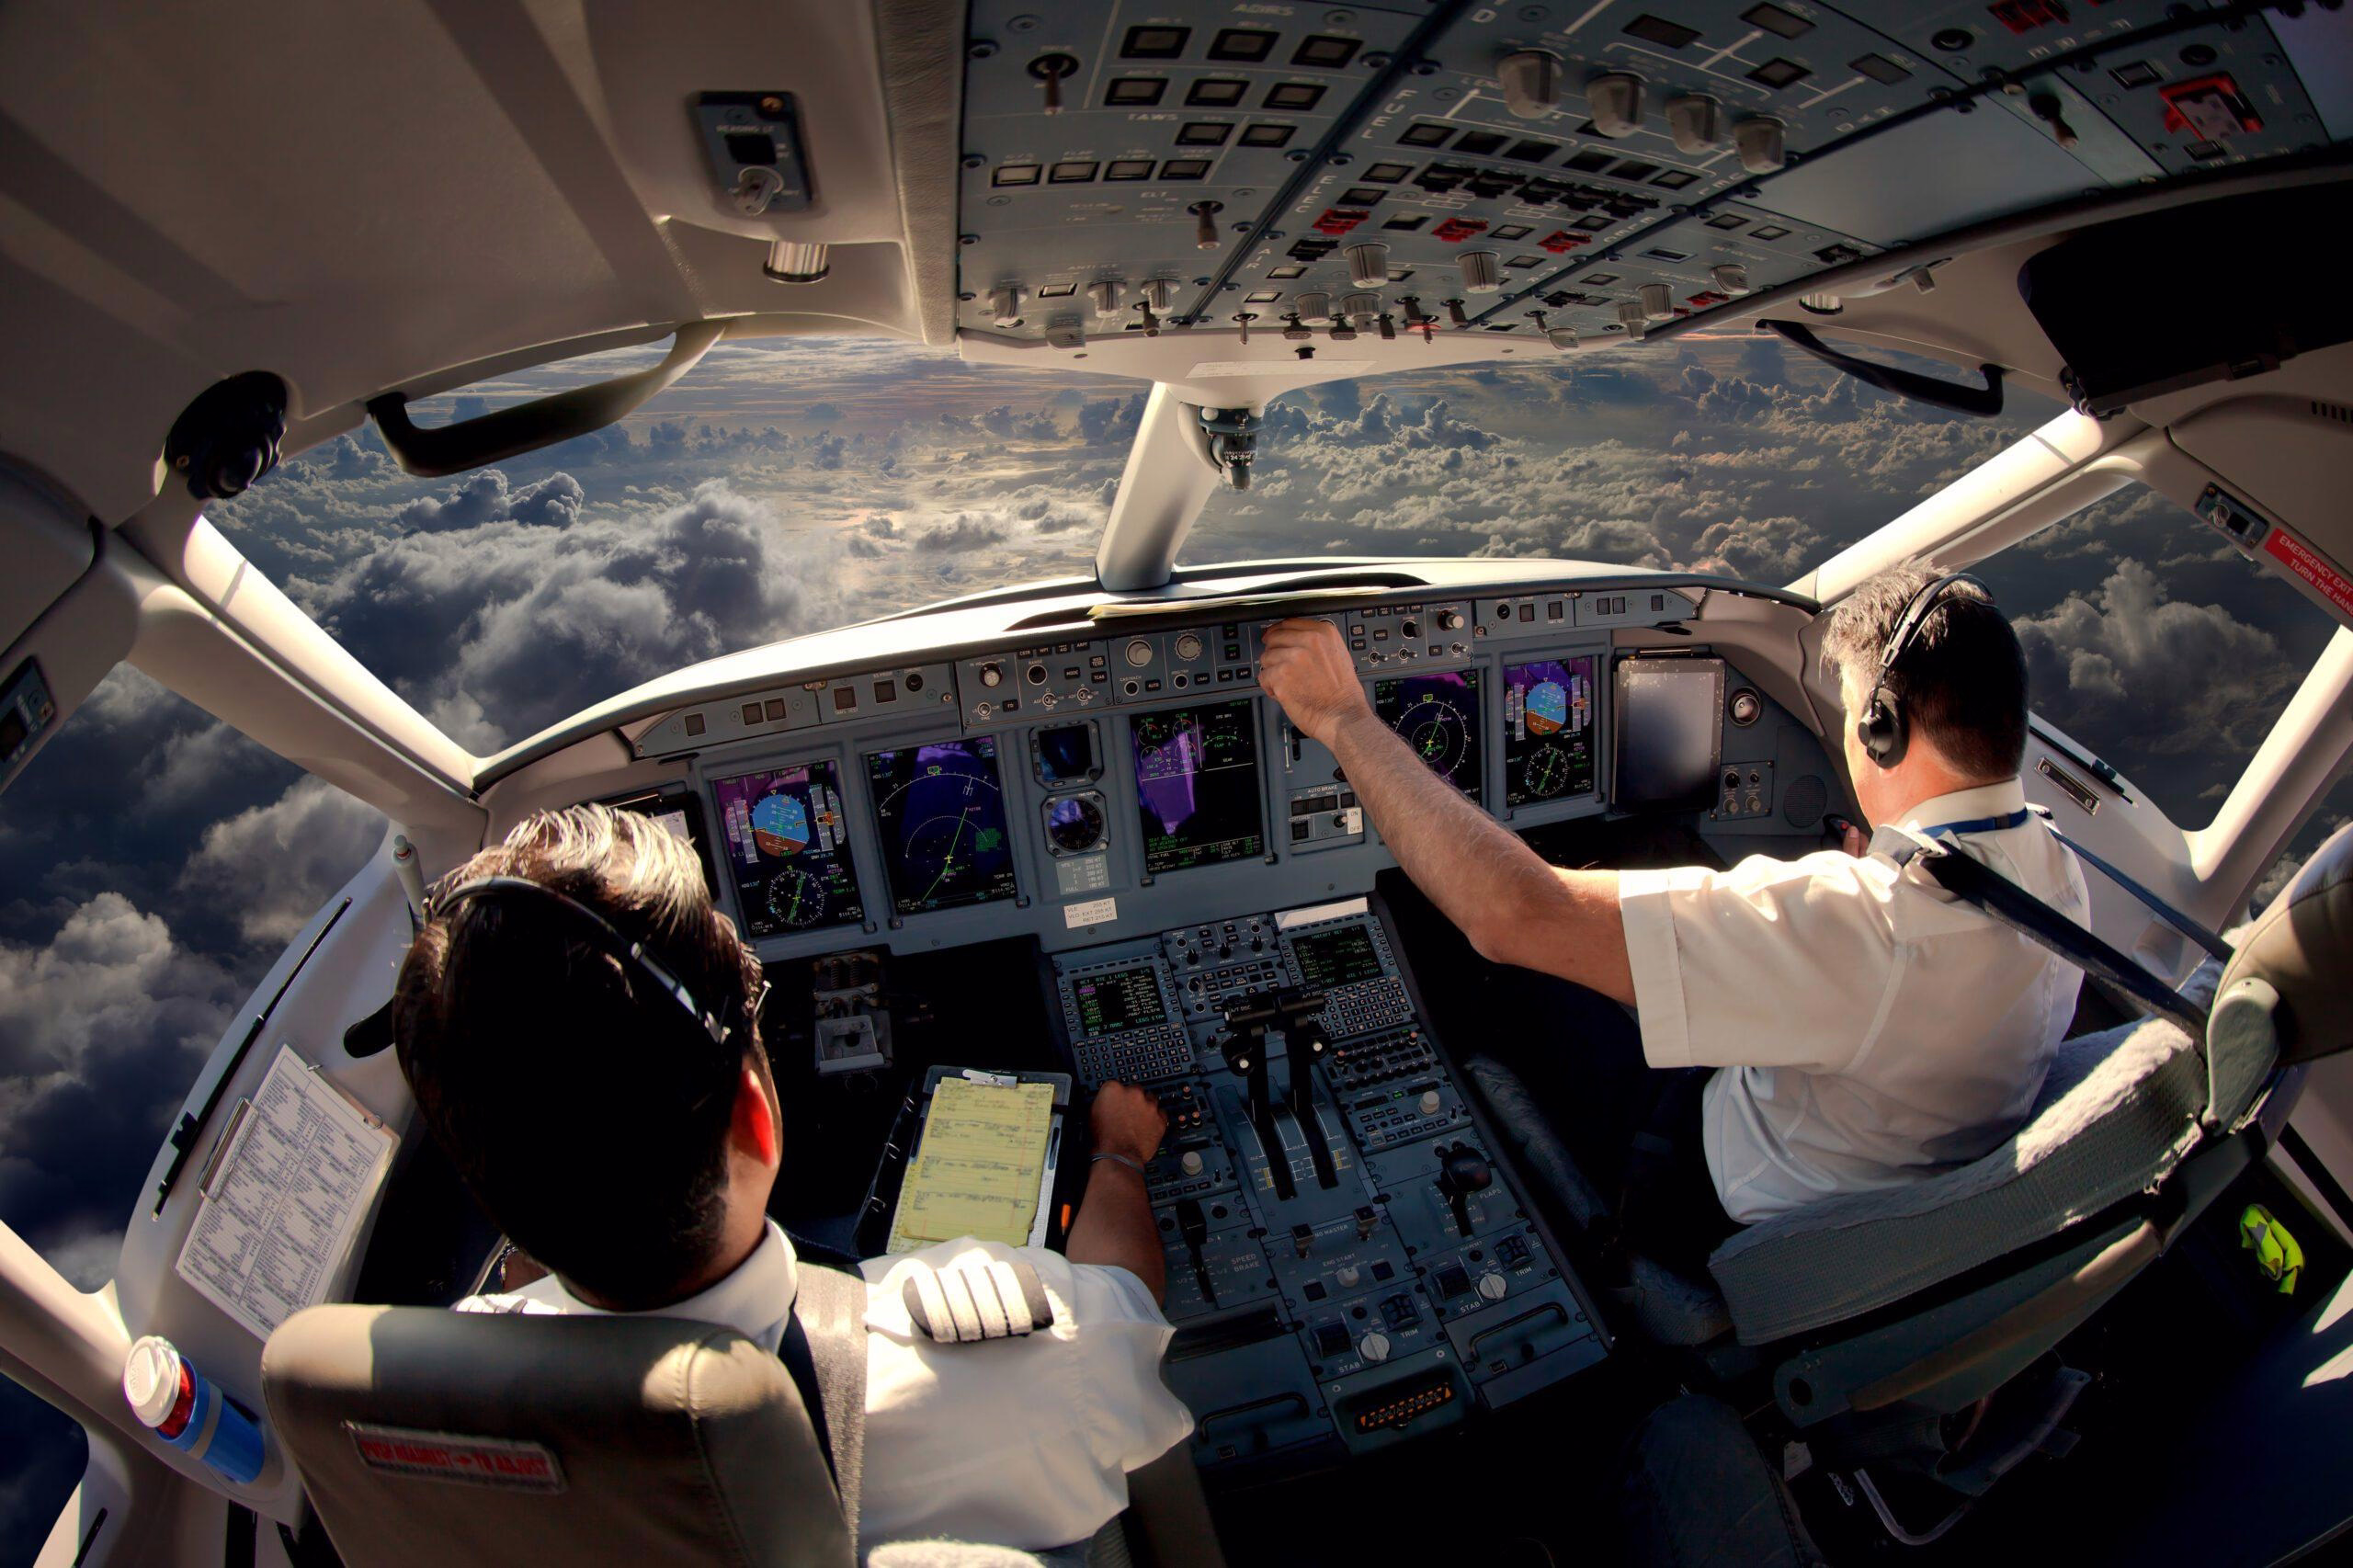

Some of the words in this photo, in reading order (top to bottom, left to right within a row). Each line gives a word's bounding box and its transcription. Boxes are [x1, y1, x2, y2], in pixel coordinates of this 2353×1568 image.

[1232, 4, 1295, 17] ADIRS
[1128, 113, 1178, 121] TAWS
[1362, 90, 1418, 139] FUEL
[1295, 176, 1337, 213] ELEC
[1246, 248, 1270, 268] AIR
[2279, 535, 2335, 579] EMERGENCY
[2333, 577, 2353, 595] EXIT
[2290, 559, 2316, 582] TURN
[2316, 578, 2334, 596] THE
[1479, 1188, 1502, 1199] FLAPS
[1325, 1223, 1348, 1236] MASTER
[1231, 1254, 1257, 1265] SPEED
[1322, 1257, 1336, 1267] ENG
[1336, 1252, 1357, 1265] START
[1233, 1261, 1260, 1273] BRAKE
[1515, 1266, 1533, 1277] TRIM
[1460, 1301, 1482, 1314] STAB
[1400, 1328, 1419, 1339] TRIM
[1338, 1361, 1361, 1374] STAB
